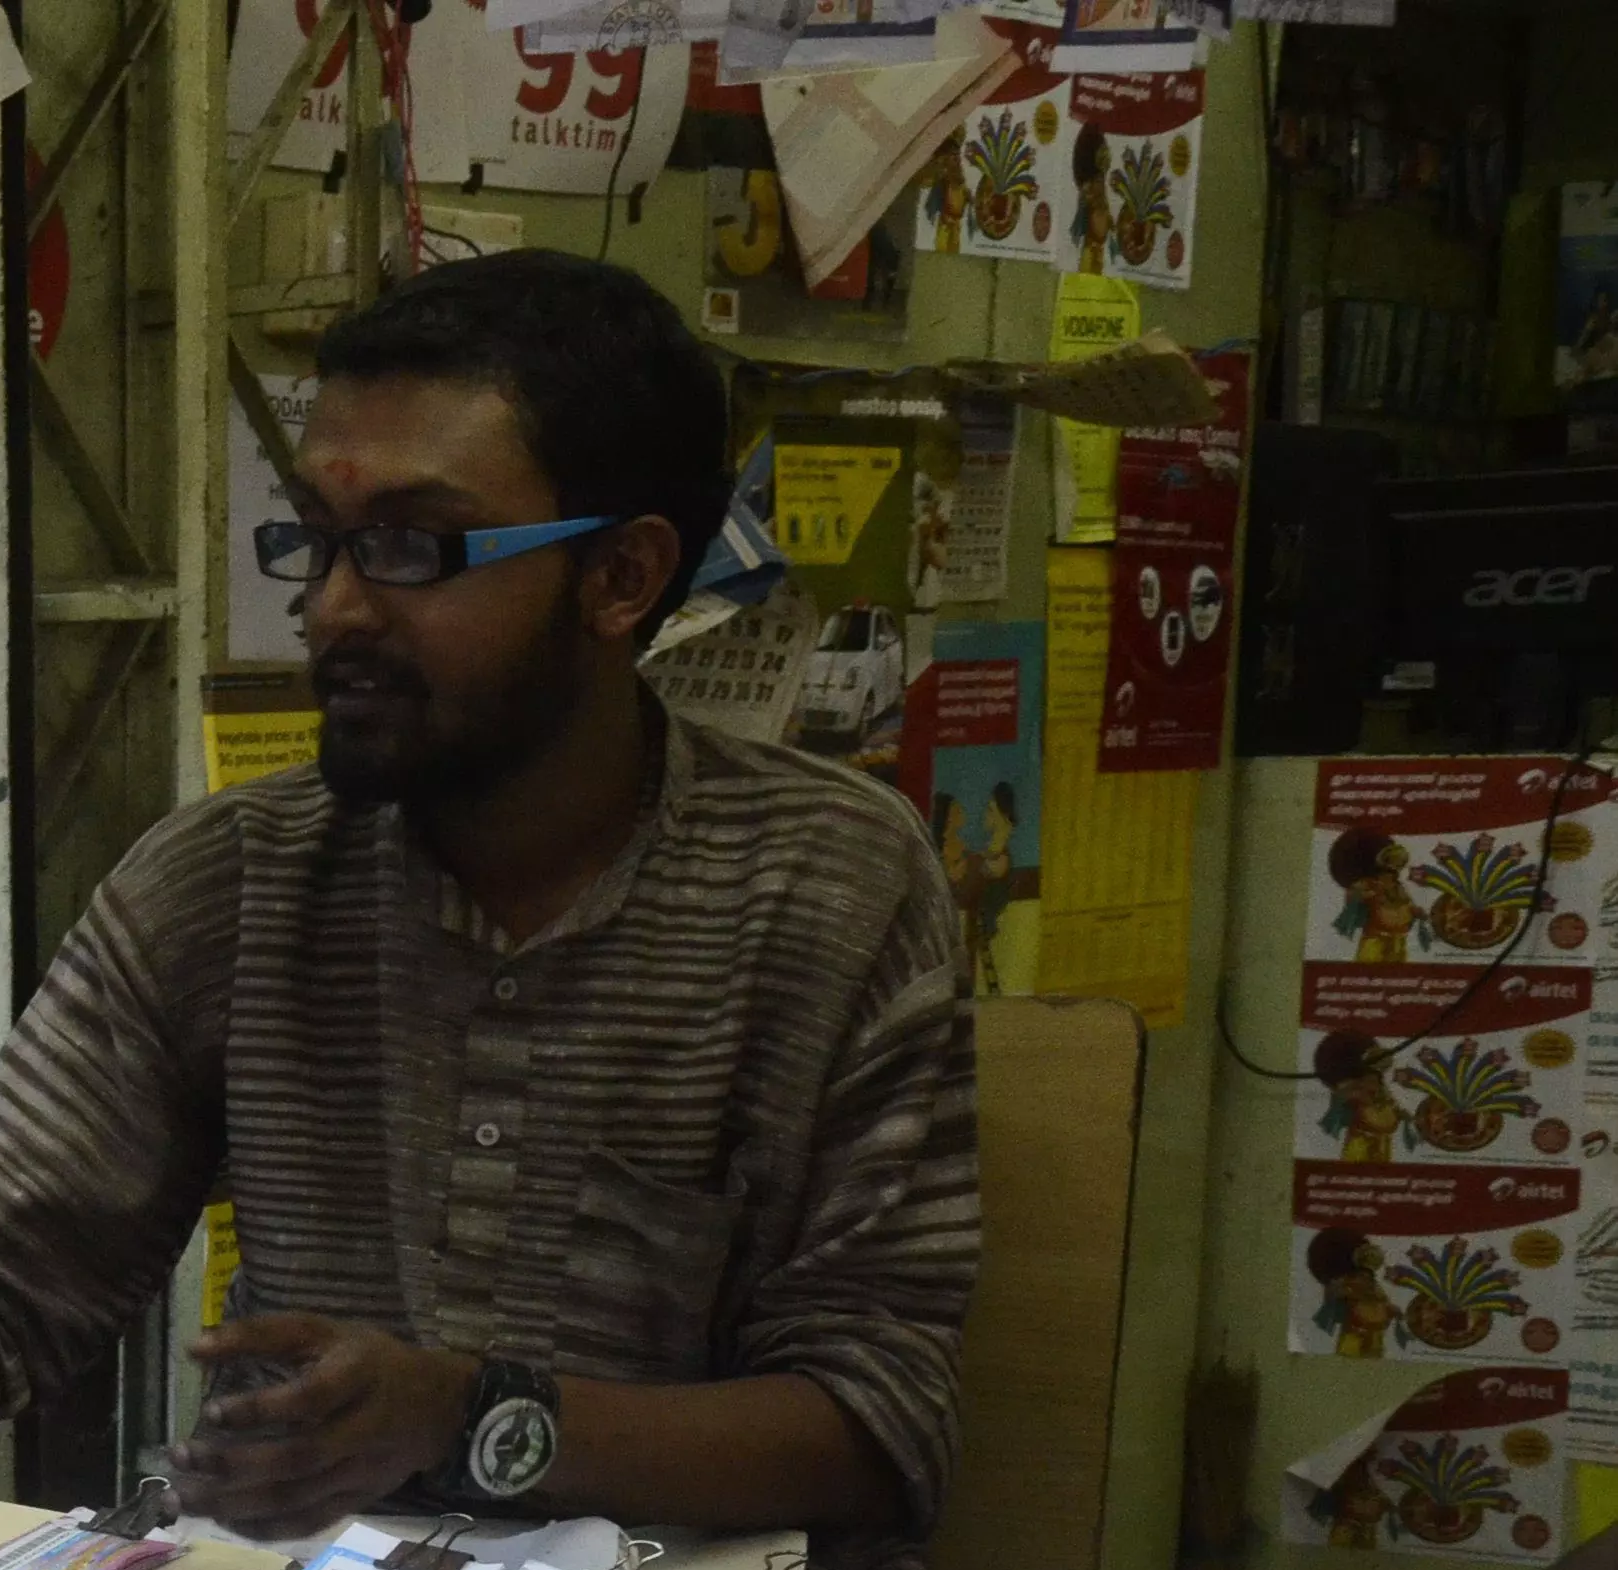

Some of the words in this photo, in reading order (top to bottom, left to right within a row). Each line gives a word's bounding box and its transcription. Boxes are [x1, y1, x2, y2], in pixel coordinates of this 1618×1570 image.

[510, 115, 630, 151] talktim
[1463, 564, 1617, 607] acer
[1529, 981, 1577, 999] airtel
[1517, 1181, 1567, 1199] airtel
[1506, 1380, 1555, 1400] airtel
